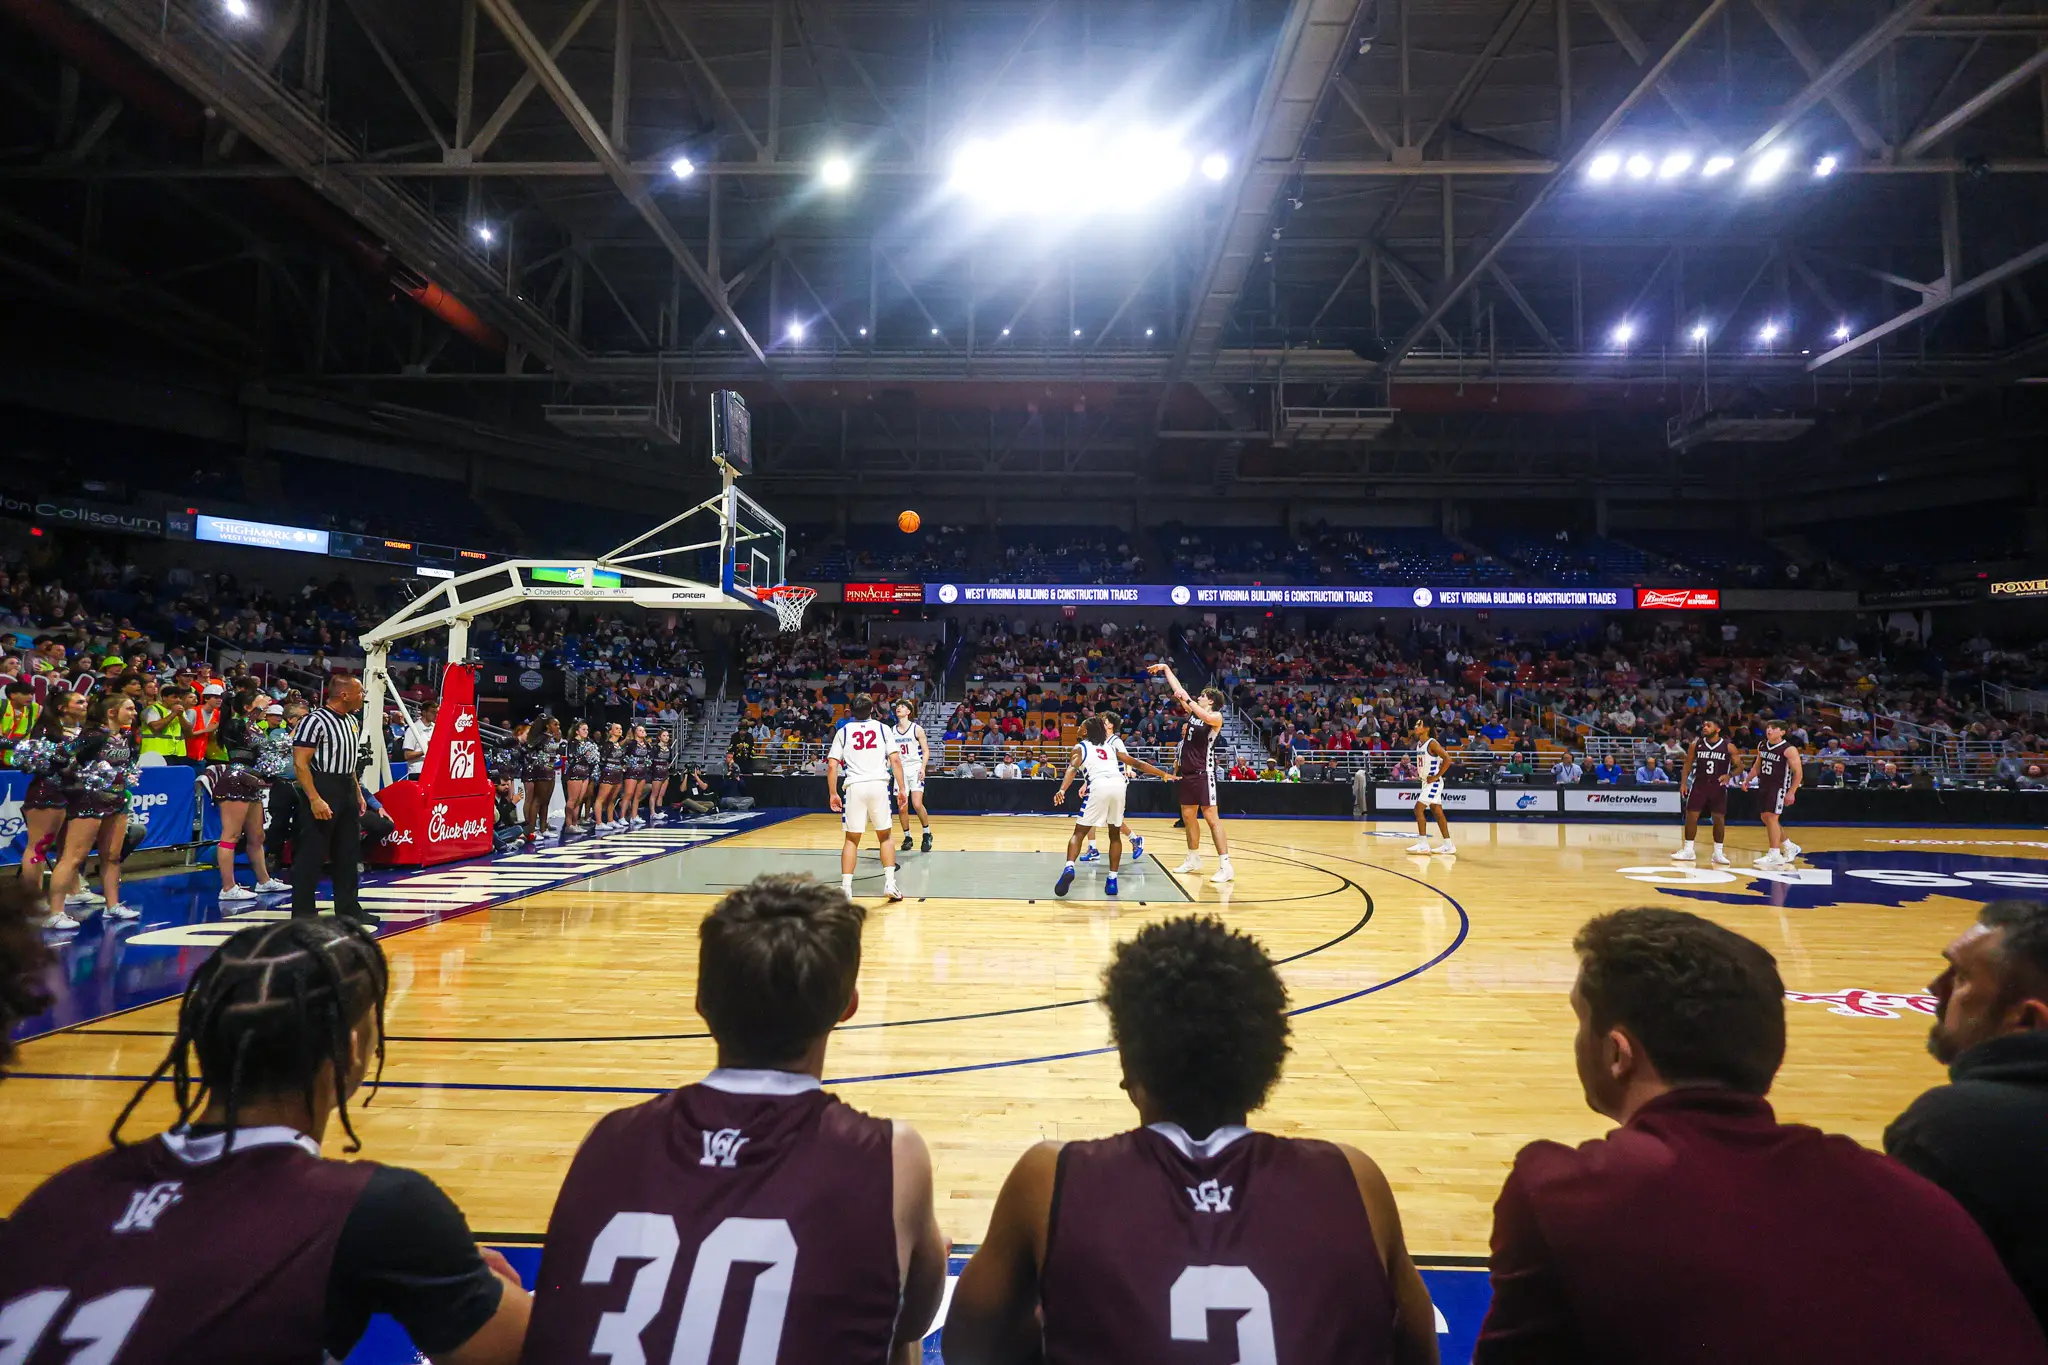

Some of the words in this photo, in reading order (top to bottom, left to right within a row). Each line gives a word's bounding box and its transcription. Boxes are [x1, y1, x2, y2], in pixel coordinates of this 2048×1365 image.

[219, 523, 290, 540] HIGHMARK
[220, 532, 242, 541] WEST
[243, 534, 281, 546] VIRGINIA
[534, 588, 577, 596] Charleston
[579, 588, 605, 596] Coliseum
[847, 586, 890, 598] PINNACLE
[965, 588, 985, 600] WEST
[986, 588, 1016, 600] VIRGINIA
[1018, 588, 1049, 600] BUILDING
[1050, 589, 1056, 600] &
[1057, 589, 1109, 600] CONSTRUCTION
[1110, 589, 1138, 601] TRADES
[1198, 590, 1218, 601] WEST
[1220, 590, 1249, 601] VIRGINIA
[1251, 590, 1283, 602] BUILDING
[1284, 590, 1290, 602] &
[1291, 591, 1344, 602] CONSTRUCTION
[1345, 591, 1373, 603] TRADES
[1440, 591, 1460, 603] WEST
[1462, 592, 1492, 603] VIRGINIA
[1494, 592, 1526, 604] BUILDING
[1527, 592, 1533, 604] &
[1534, 592, 1587, 604] CONSTRUCTION
[1588, 592, 1617, 605] TRADES
[852, 730, 877, 751] 32
[900, 744, 909, 755] 31
[1095, 748, 1108, 760] 3
[1696, 751, 1710, 759] THE
[1710, 752, 1726, 760] HILL
[1705, 760, 1715, 774] 3
[1761, 760, 1773, 775] 25
[1600, 793, 1658, 805] MetroNews
[581, 1211, 799, 1365] 30
